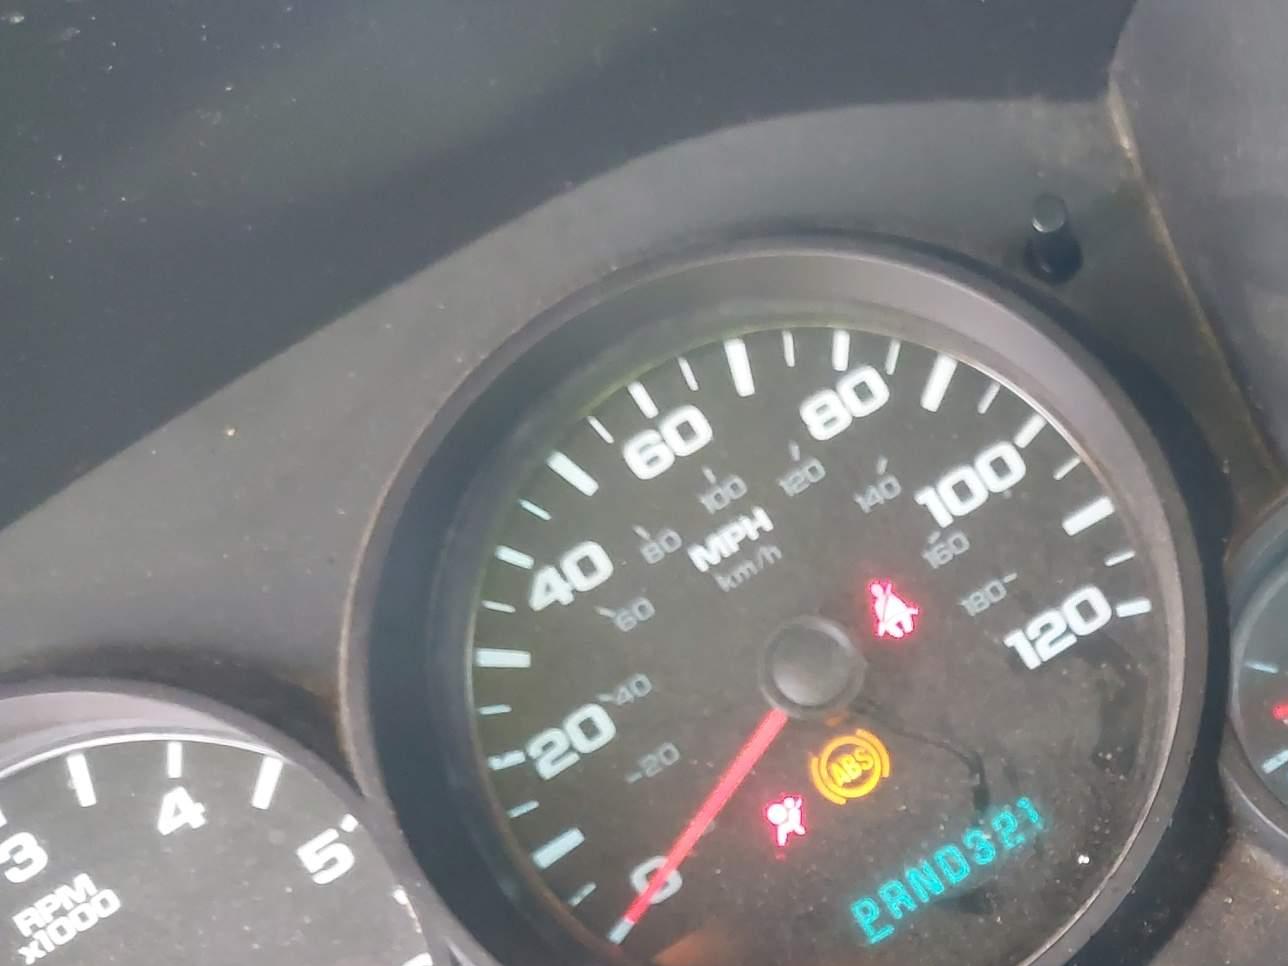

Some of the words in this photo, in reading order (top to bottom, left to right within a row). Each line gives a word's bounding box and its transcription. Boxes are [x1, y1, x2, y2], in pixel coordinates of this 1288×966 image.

[800, 365, 890, 440] 80
[623, 405, 713, 480] 60
[700, 475, 748, 514] 100
[777, 457, 826, 497] 120
[854, 475, 902, 513] 140
[914, 441, 1026, 528] 100
[640, 528, 682, 564] 80
[687, 505, 774, 572] MPH
[922, 530, 970, 569] 160
[529, 541, 614, 611] 40
[713, 543, 782, 592] km/h
[614, 597, 656, 632] 60
[960, 579, 1007, 616] 180
[1003, 585, 1112, 670] 120
[614, 673, 652, 706] 40
[525, 704, 616, 780] 20
[638, 742, 681, 779] 20
[830, 747, 874, 788] ABS
[157, 786, 207, 836] 4
[0, 831, 48, 883] 3
[296, 828, 356, 885] 5
[851, 797, 1043, 945] PRND321
[12, 873, 98, 938] RPM
[18, 889, 121, 965] x1000
